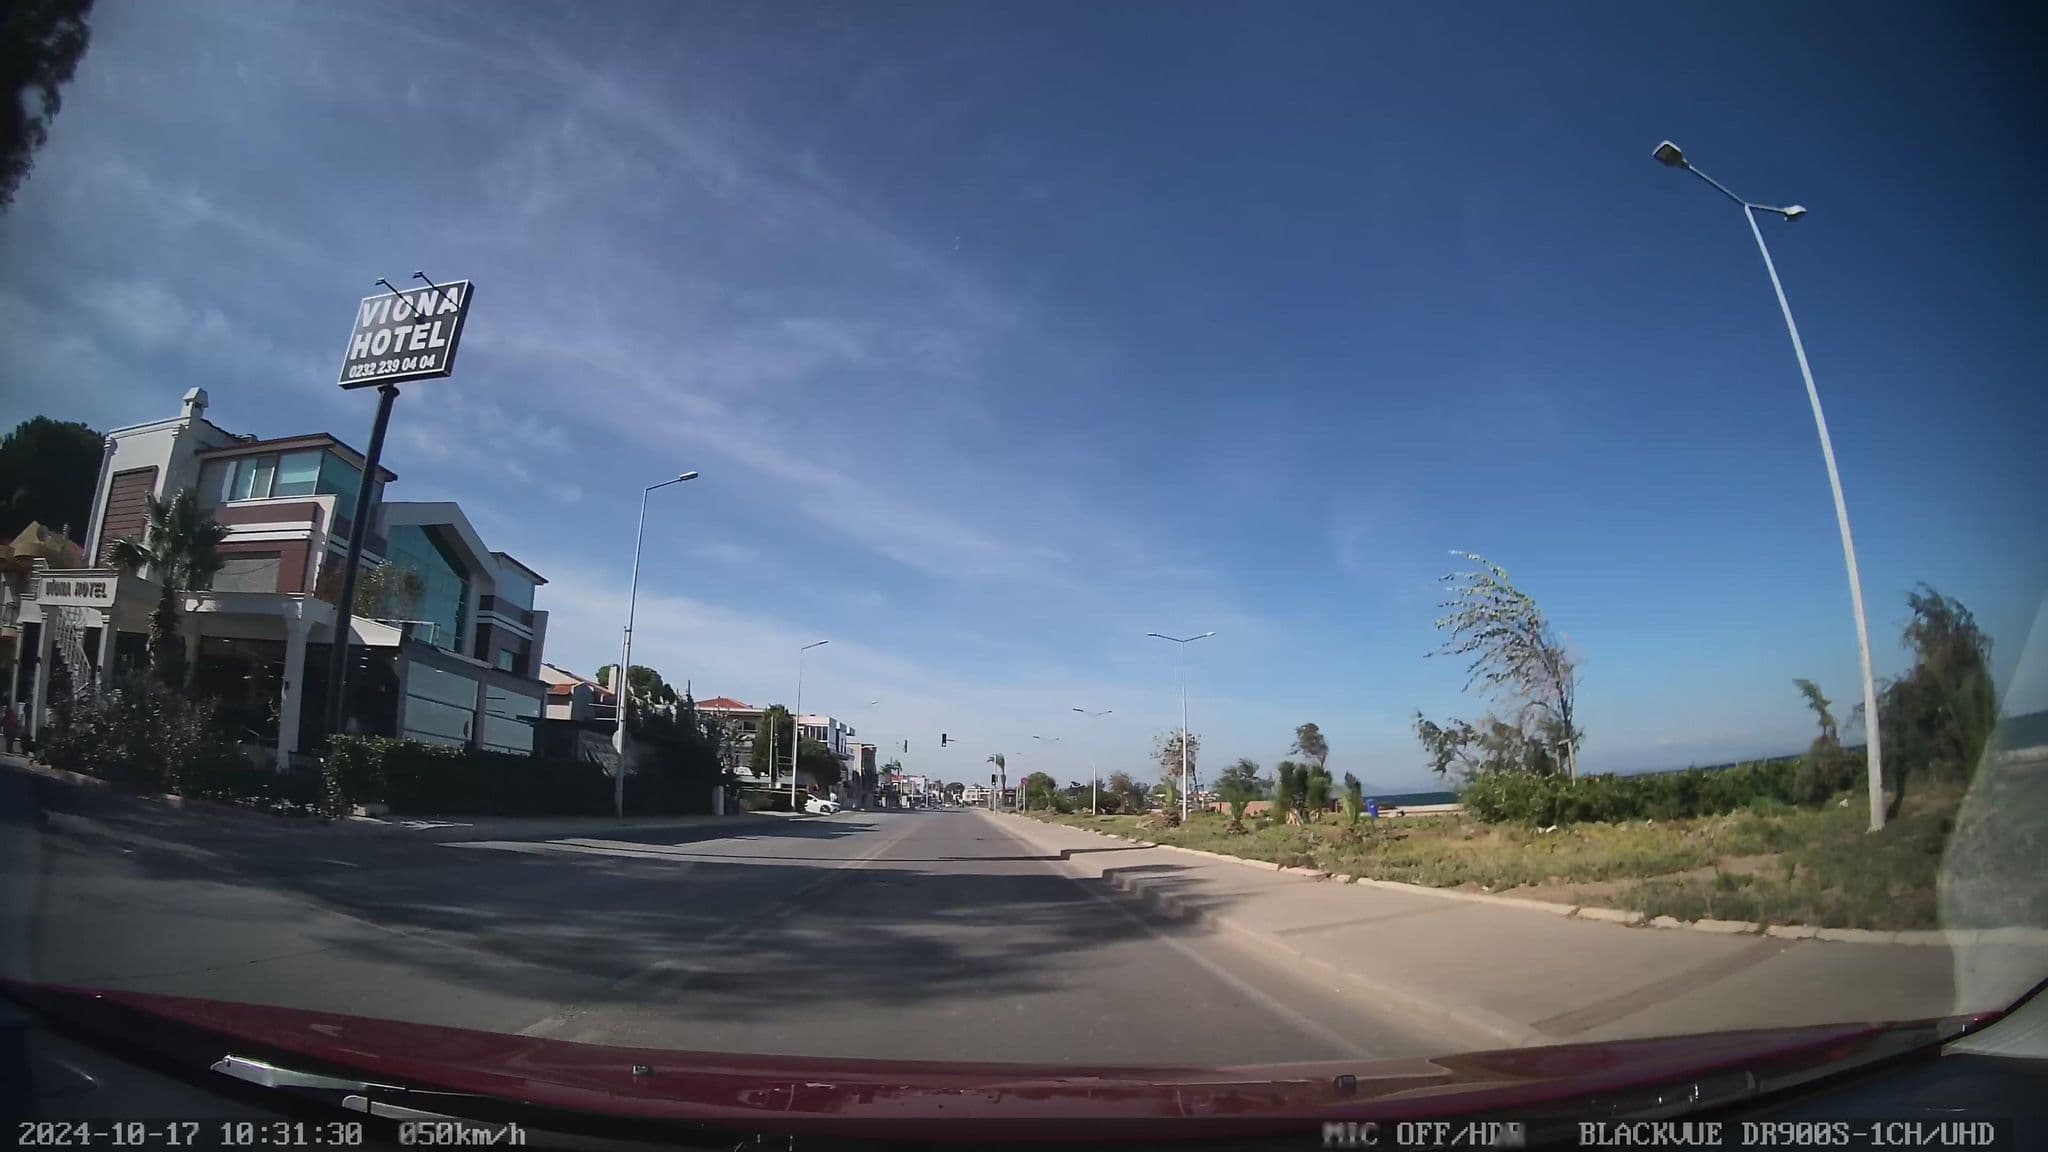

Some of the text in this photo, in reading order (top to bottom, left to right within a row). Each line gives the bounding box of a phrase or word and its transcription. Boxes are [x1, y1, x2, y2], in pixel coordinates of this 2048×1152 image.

[362, 287, 458, 327] VIONA
[350, 321, 445, 360] HOTEL
[349, 354, 436, 378] 0232 239 04 04
